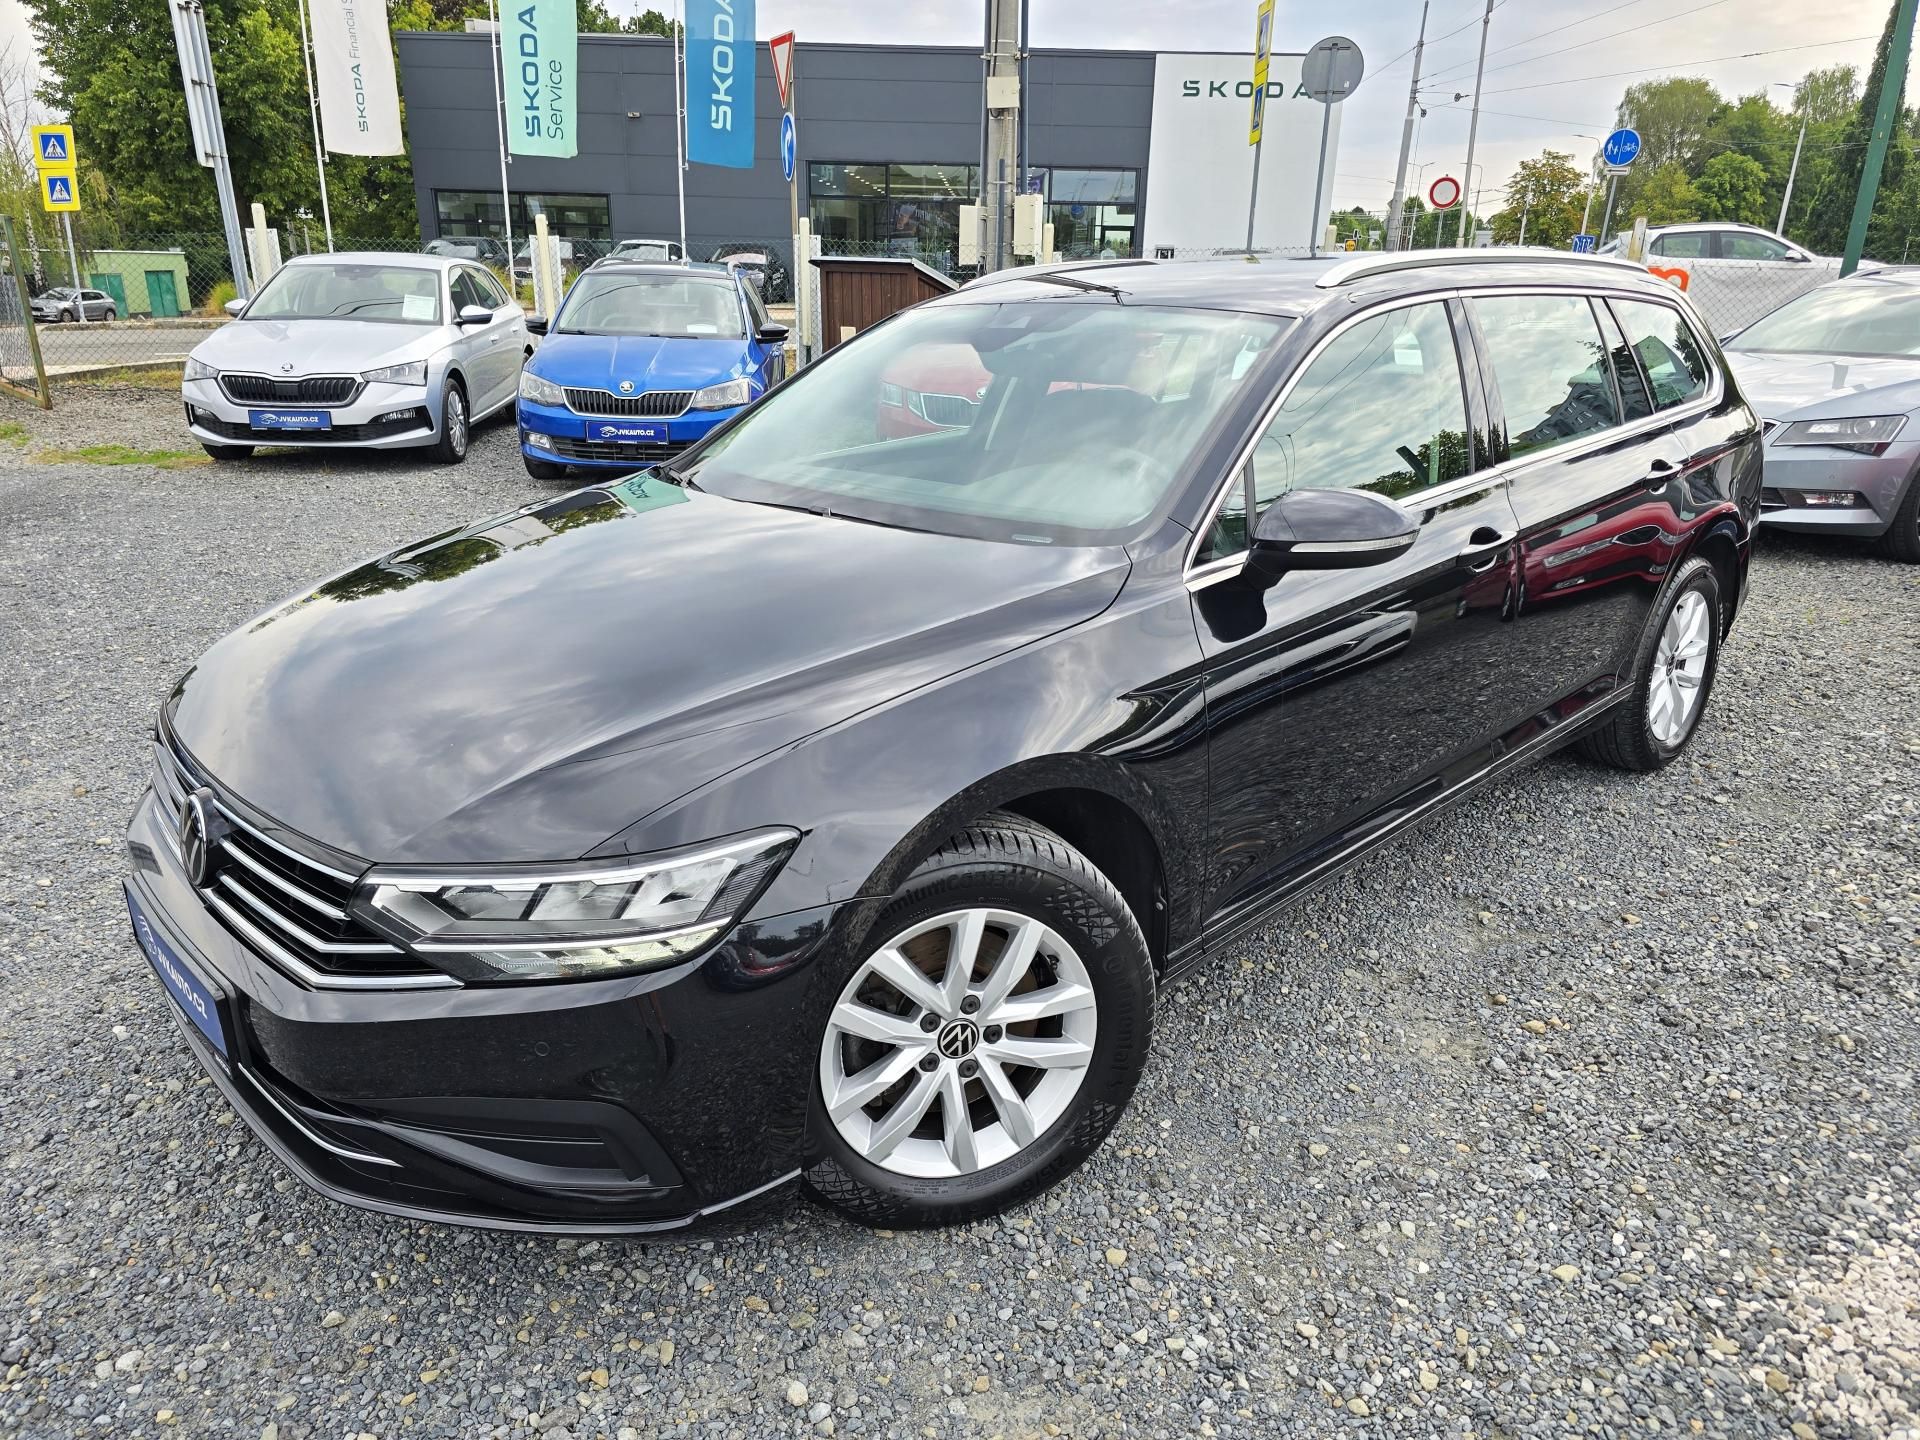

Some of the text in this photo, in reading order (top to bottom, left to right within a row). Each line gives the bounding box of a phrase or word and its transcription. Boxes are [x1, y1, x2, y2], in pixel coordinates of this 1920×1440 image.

[343, 8, 361, 59] Financial
[545, 59, 564, 140] Service
[878, 872, 1025, 921] emiumContact
